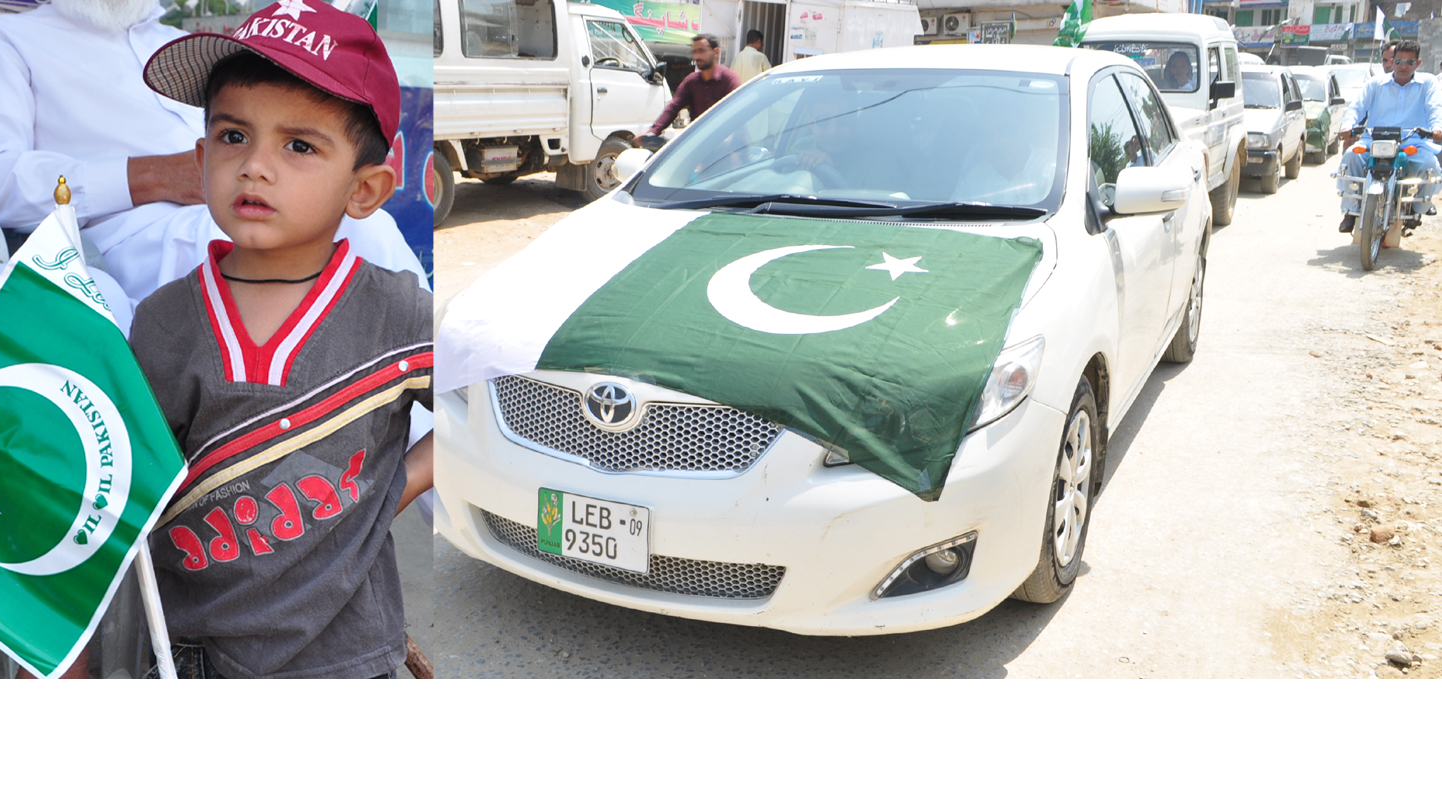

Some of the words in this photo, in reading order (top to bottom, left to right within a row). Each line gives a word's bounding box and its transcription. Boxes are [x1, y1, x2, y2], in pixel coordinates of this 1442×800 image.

[60, 380, 114, 468] PAKISTAN
[210, 480, 250, 502] FASHION
[572, 501, 612, 530] LEB
[540, 538, 561, 549] PUNJAB
[565, 529, 617, 560] 9350
